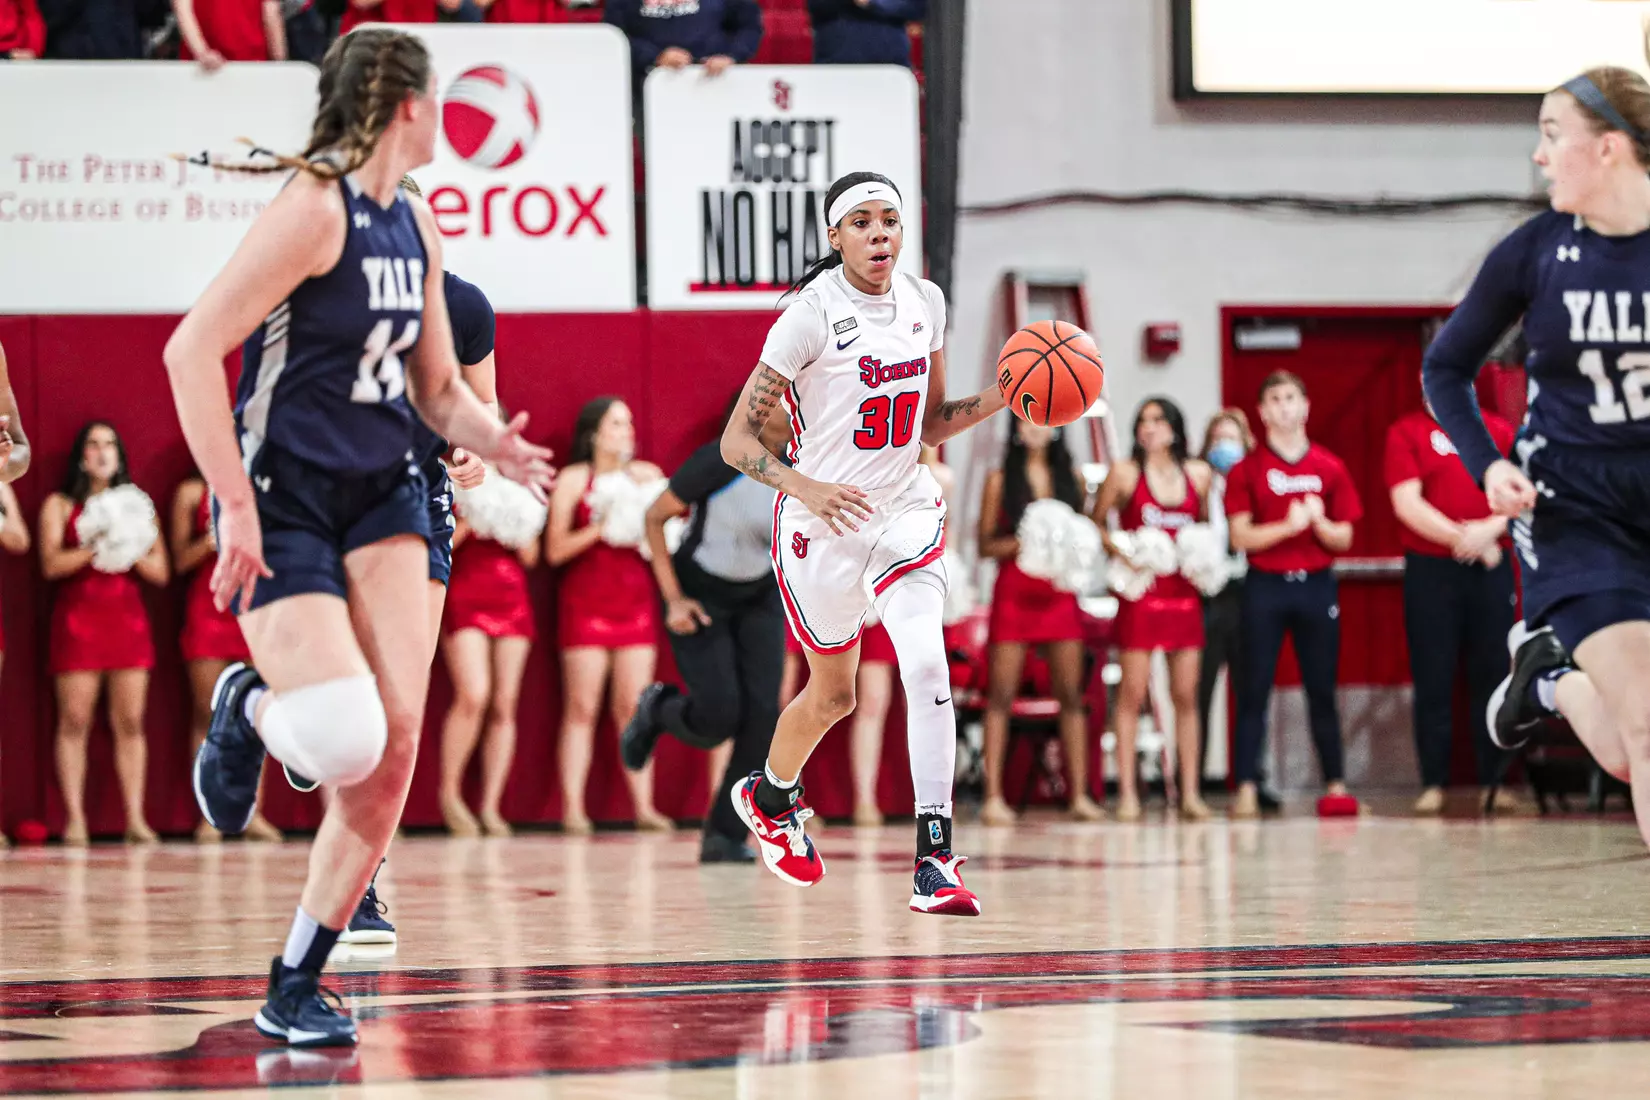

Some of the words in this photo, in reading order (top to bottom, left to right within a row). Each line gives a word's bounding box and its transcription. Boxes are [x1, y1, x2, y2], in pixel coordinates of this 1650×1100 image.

[731, 119, 835, 184] ACCEPT
[427, 185, 608, 238] erox
[702, 189, 755, 288] NO
[771, 189, 830, 286] HA
[1576, 349, 1650, 424] 12
[853, 390, 920, 450] 30
